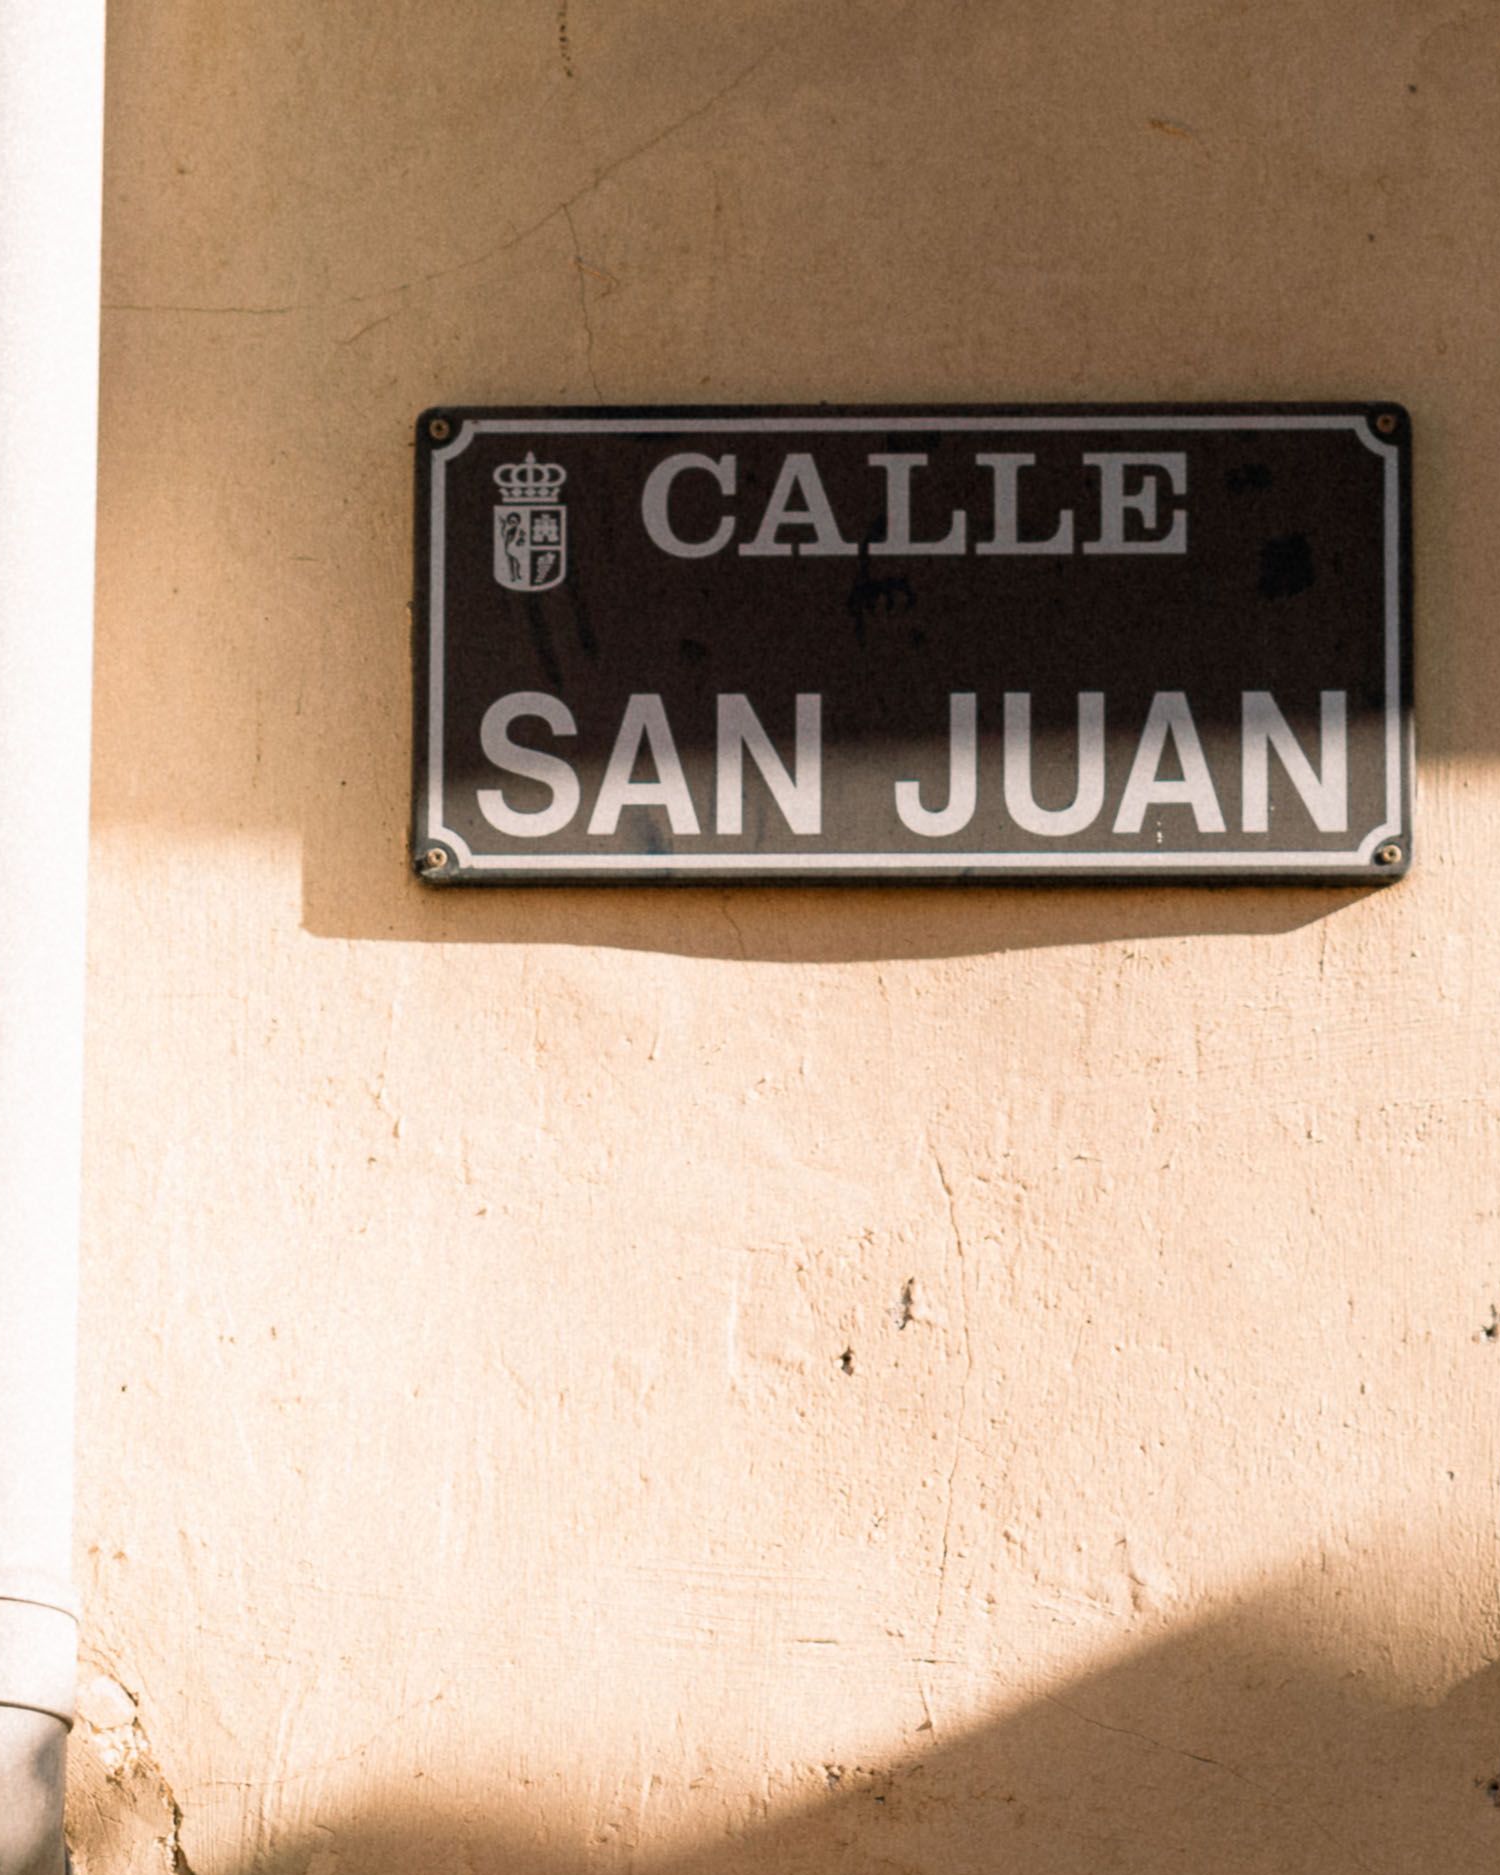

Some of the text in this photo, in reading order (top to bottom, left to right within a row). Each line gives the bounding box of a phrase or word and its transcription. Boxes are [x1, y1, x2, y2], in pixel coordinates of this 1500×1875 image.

[641, 453, 1187, 558] CALLE
[476, 691, 1349, 838] SAN JUAN
